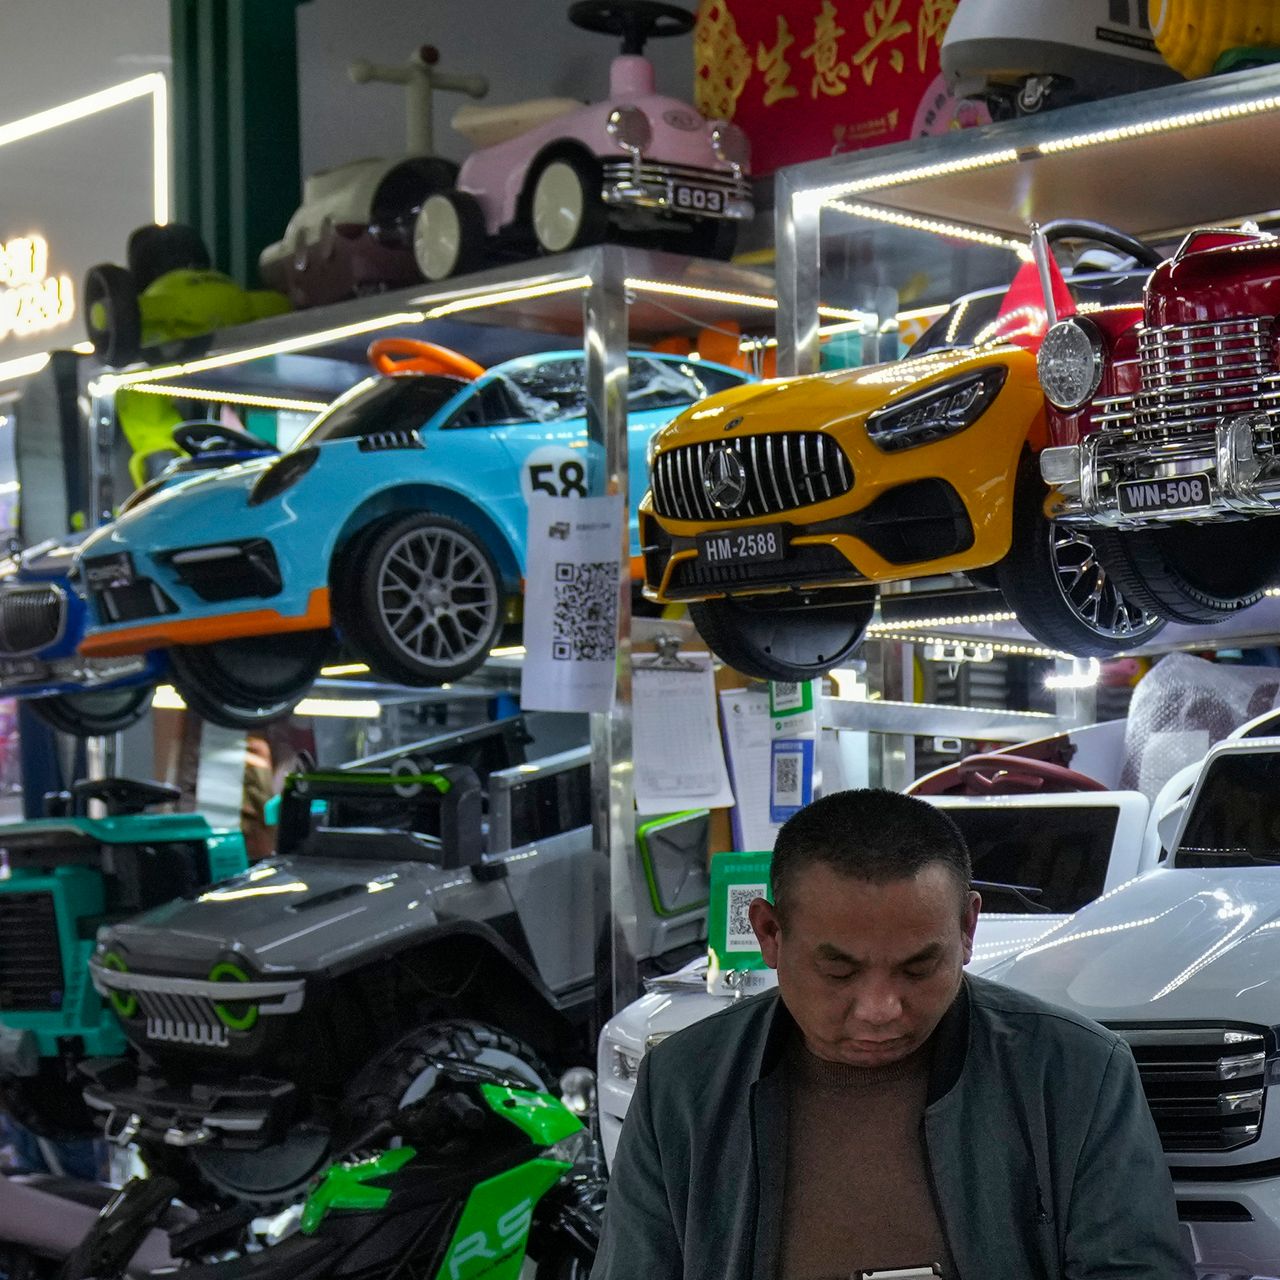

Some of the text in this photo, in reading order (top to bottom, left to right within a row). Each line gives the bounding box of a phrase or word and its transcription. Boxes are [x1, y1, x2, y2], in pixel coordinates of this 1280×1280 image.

[529, 461, 588, 498] 58
[1126, 480, 1204, 508] WN-508
[705, 532, 777, 561] HM-2588
[448, 1199, 532, 1280] RS
